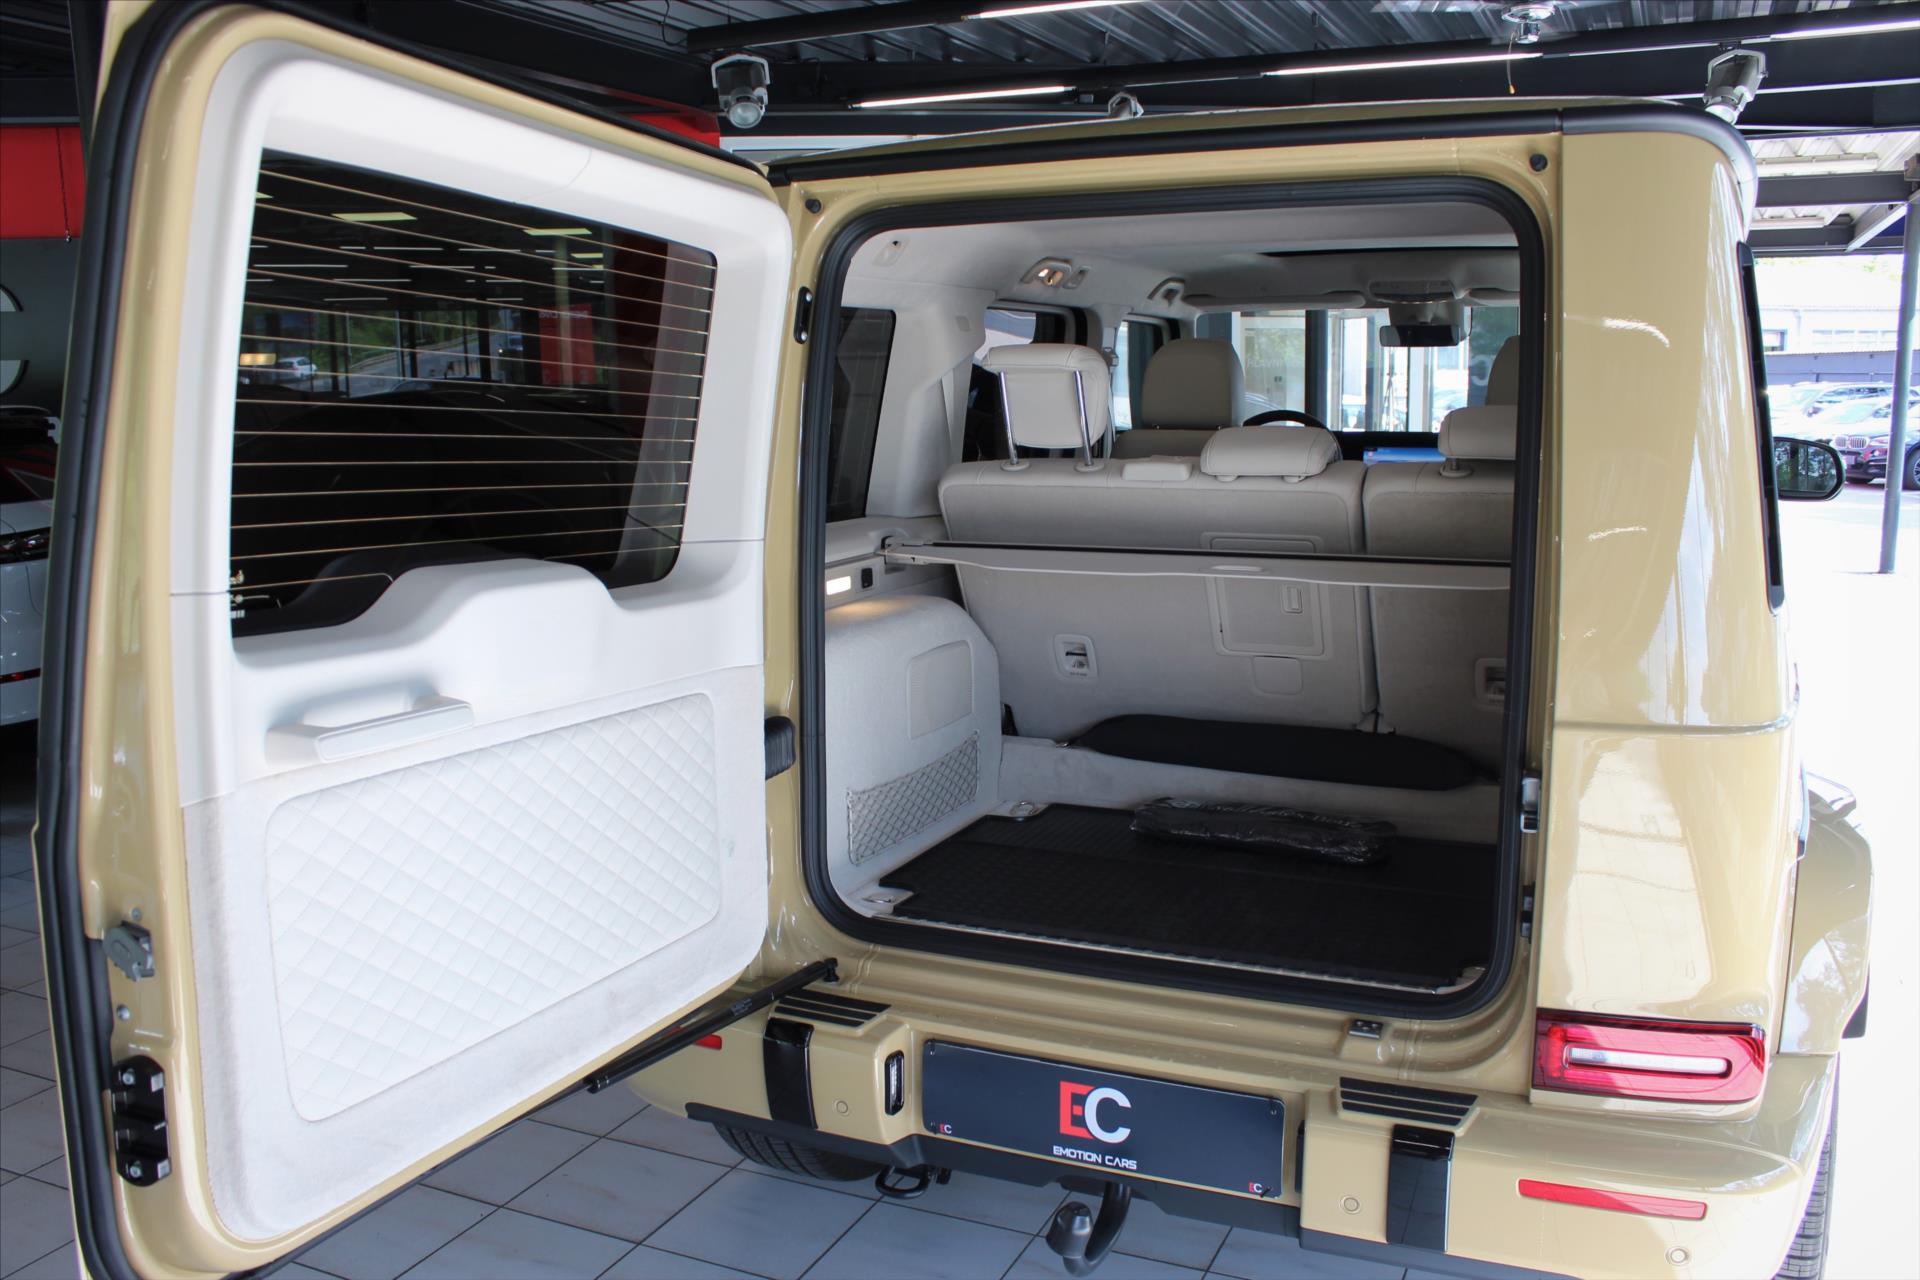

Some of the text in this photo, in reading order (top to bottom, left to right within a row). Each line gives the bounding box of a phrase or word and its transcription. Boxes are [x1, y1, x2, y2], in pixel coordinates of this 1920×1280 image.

[1060, 1081, 1132, 1144] EC
[1053, 1145, 1137, 1170] EMOTION CARS
